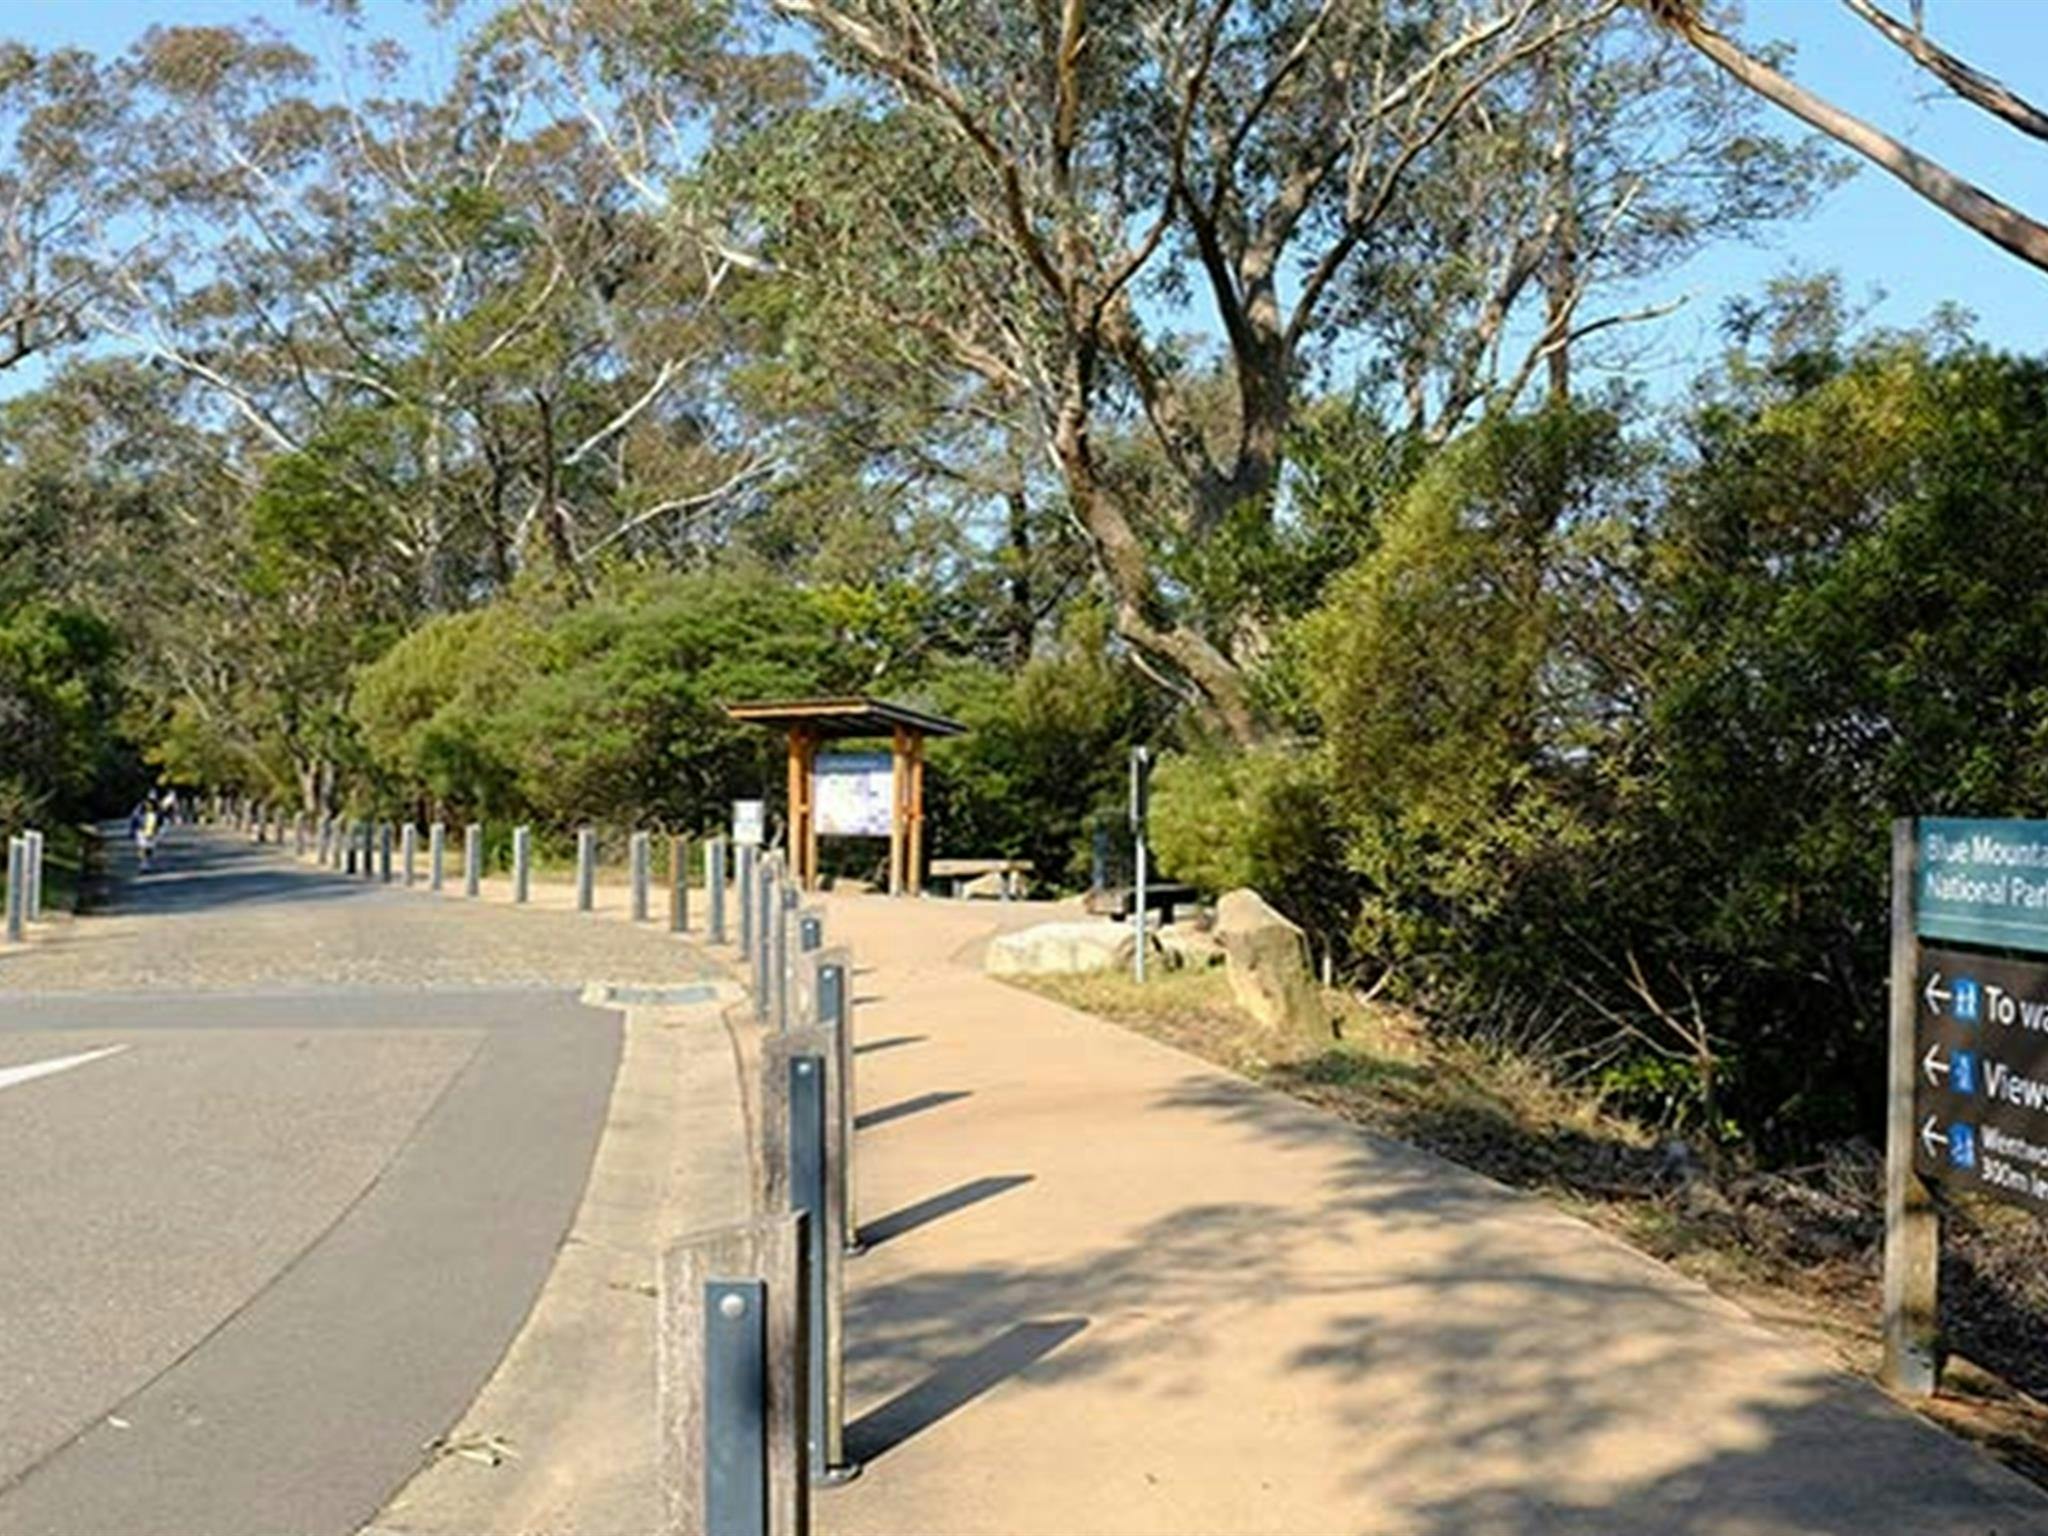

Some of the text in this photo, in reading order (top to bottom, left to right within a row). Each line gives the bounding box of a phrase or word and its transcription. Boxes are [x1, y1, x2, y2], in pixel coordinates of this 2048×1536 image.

[1926, 872, 2048, 908] National Par
[1984, 985, 2016, 1025] To
